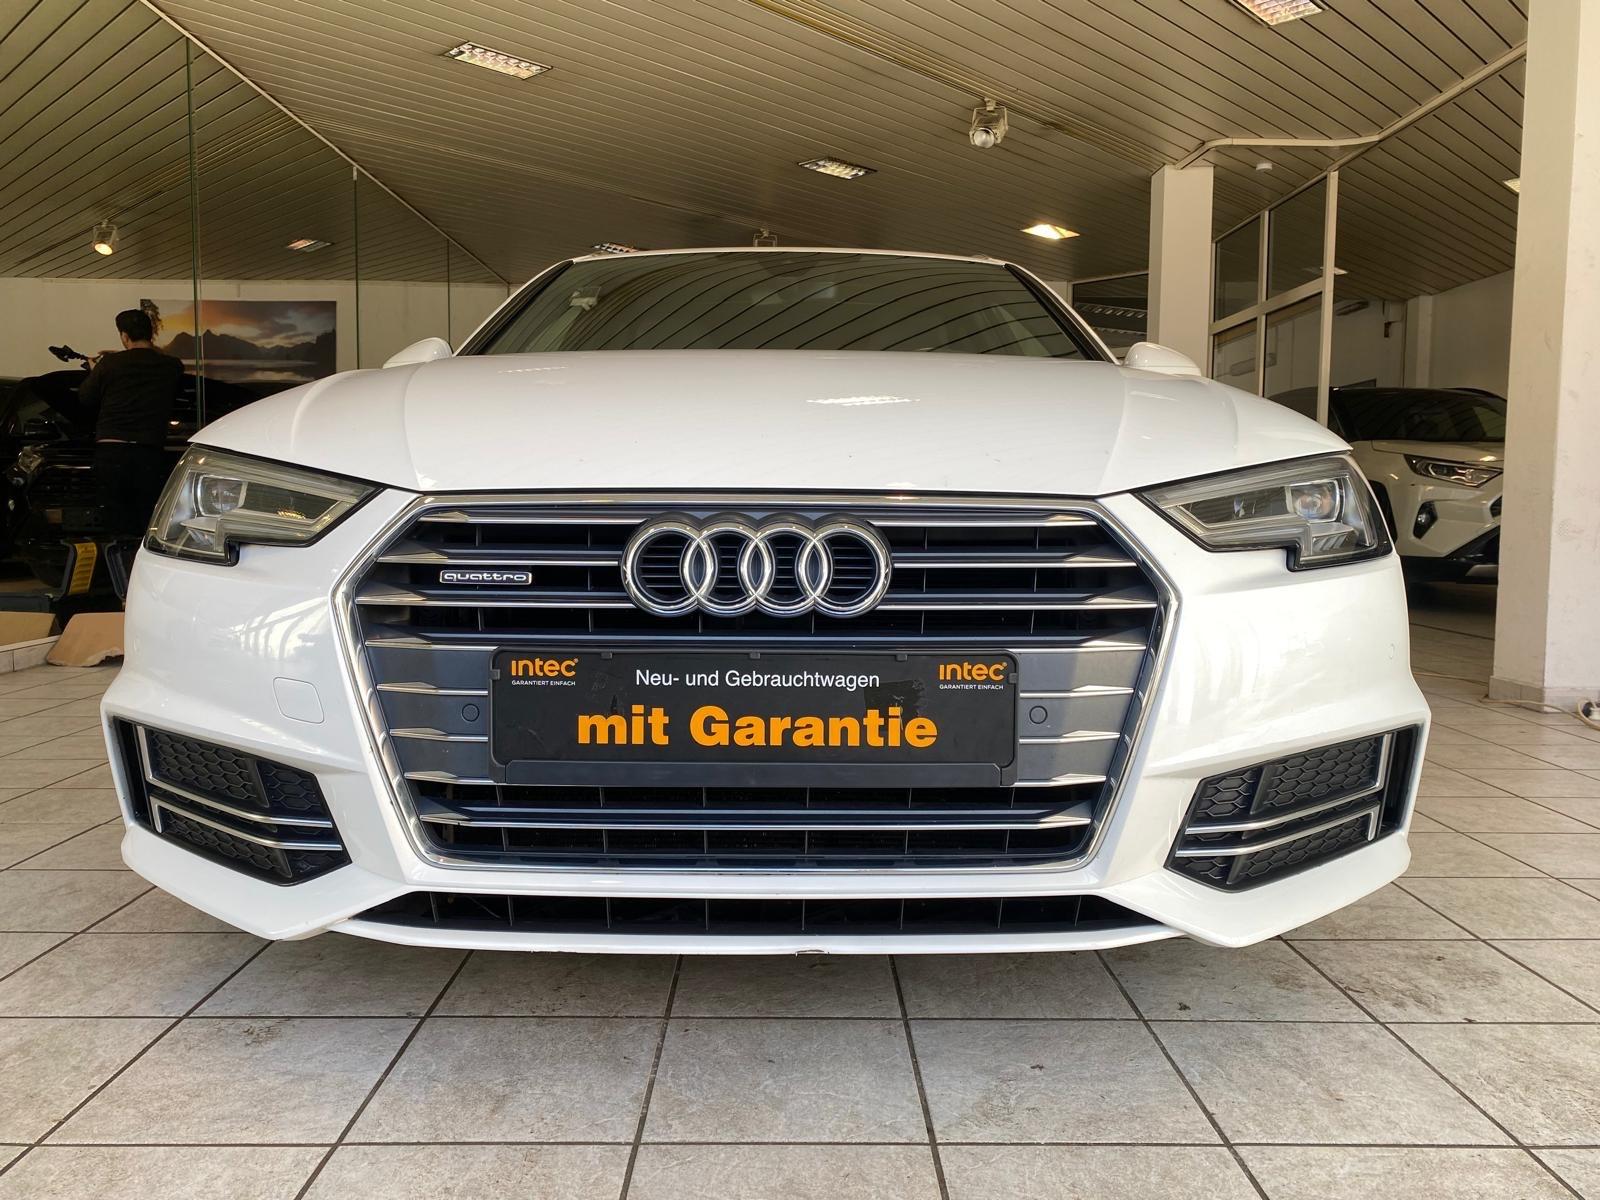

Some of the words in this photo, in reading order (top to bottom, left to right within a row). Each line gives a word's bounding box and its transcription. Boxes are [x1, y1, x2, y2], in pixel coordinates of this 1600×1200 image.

[444, 573, 527, 582] quattro
[635, 669, 680, 686] Neu-
[685, 669, 719, 687] und
[725, 670, 880, 692] Gebrauchtwagen
[577, 704, 669, 745] mit
[690, 705, 938, 748] Garantie
